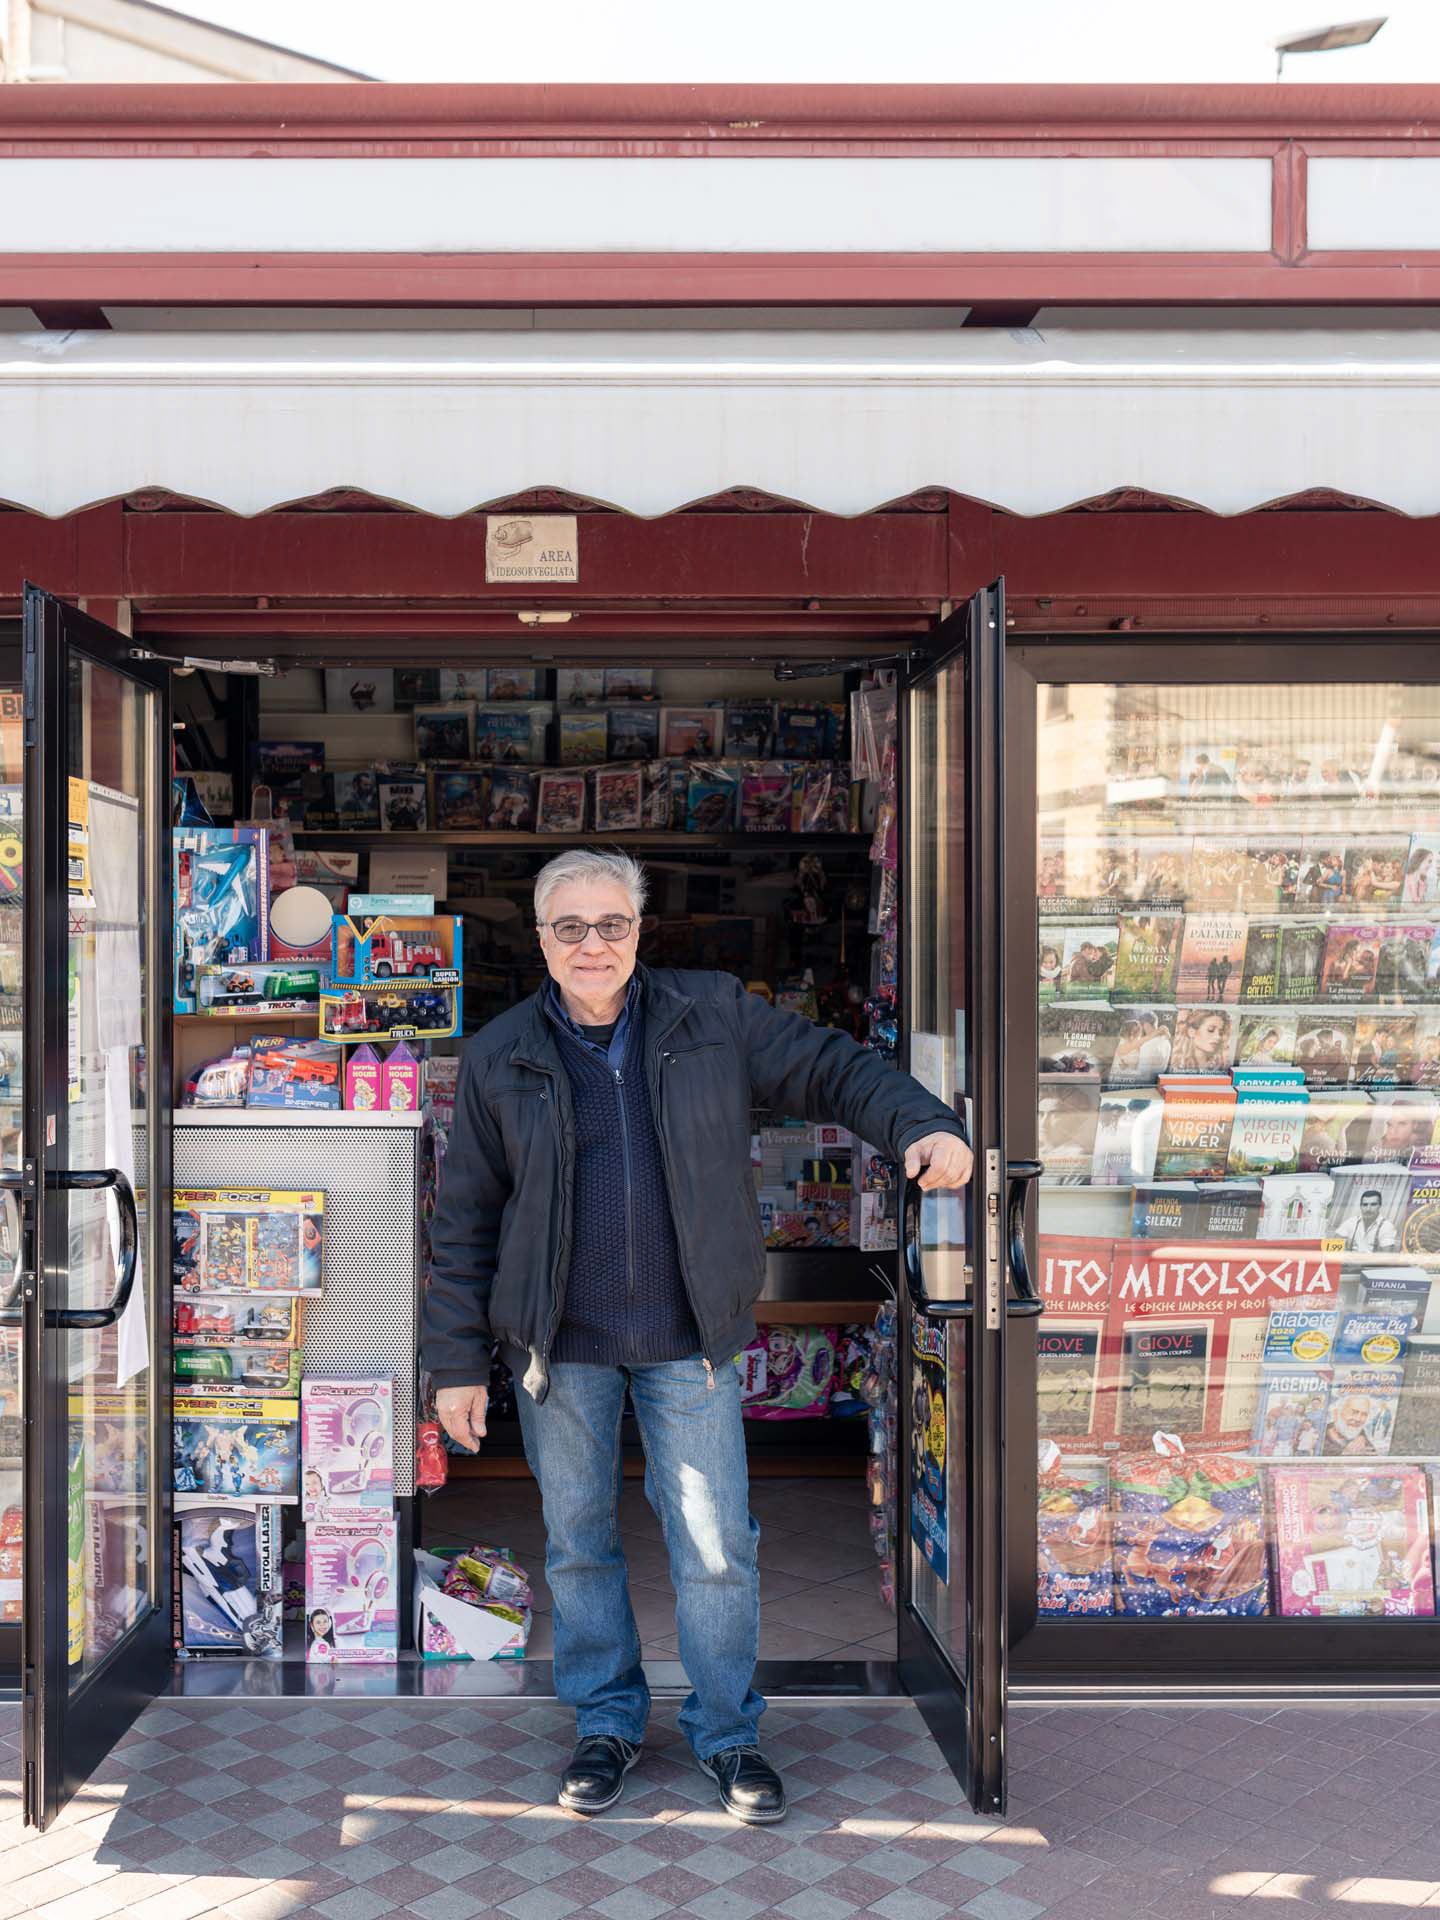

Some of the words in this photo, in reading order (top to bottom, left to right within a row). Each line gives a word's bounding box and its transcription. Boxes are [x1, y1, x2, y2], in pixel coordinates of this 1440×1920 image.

[540, 551, 572, 562] AREA
[1202, 921, 1233, 929] DIANA
[1189, 929, 1242, 939] PALMER
[1128, 954, 1169, 965] WIGGS
[268, 1001, 296, 1009] TRUCK
[254, 1037, 285, 1048] NERF
[1167, 1120, 1225, 1134] VIRGIN
[1241, 1119, 1297, 1131] VIRGIN
[1171, 1135, 1219, 1148] RIVER
[1243, 1132, 1291, 1144] RIVER
[219, 1191, 271, 1202] FORCE
[1148, 1204, 1182, 1216] NOVAK
[1210, 1206, 1247, 1217] TELLER
[1144, 1216, 1182, 1227] SILENZI
[1209, 1217, 1244, 1225] COLPEVOLE
[1208, 1224, 1243, 1232] INNOCENZA
[1038, 1258, 1113, 1296] ITO
[1118, 1258, 1332, 1299] MITOLOGIA
[1371, 1280, 1407, 1290] URANIA
[1043, 1300, 1065, 1311] CHE
[1125, 1303, 1136, 1313] LE
[1139, 1302, 1176, 1312] EPICHE
[1178, 1300, 1224, 1312] IMPRESE
[1226, 1302, 1237, 1311] DI
[1240, 1299, 1265, 1310] EROI
[1271, 1311, 1337, 1328] diabete
[1345, 1319, 1385, 1330] Padre
[1387, 1320, 1408, 1330] Pio
[1270, 1327, 1295, 1335] 2020
[204, 1335, 236, 1344] TRUCK
[1038, 1337, 1085, 1352] IOVE
[1138, 1334, 1194, 1351] GIOVE
[202, 1385, 234, 1393] TRUCK
[1269, 1376, 1328, 1392] AGENDA
[219, 1401, 263, 1409] FORCE
[262, 1505, 270, 1543] LASER
[262, 1546, 270, 1590] PISTOLA
